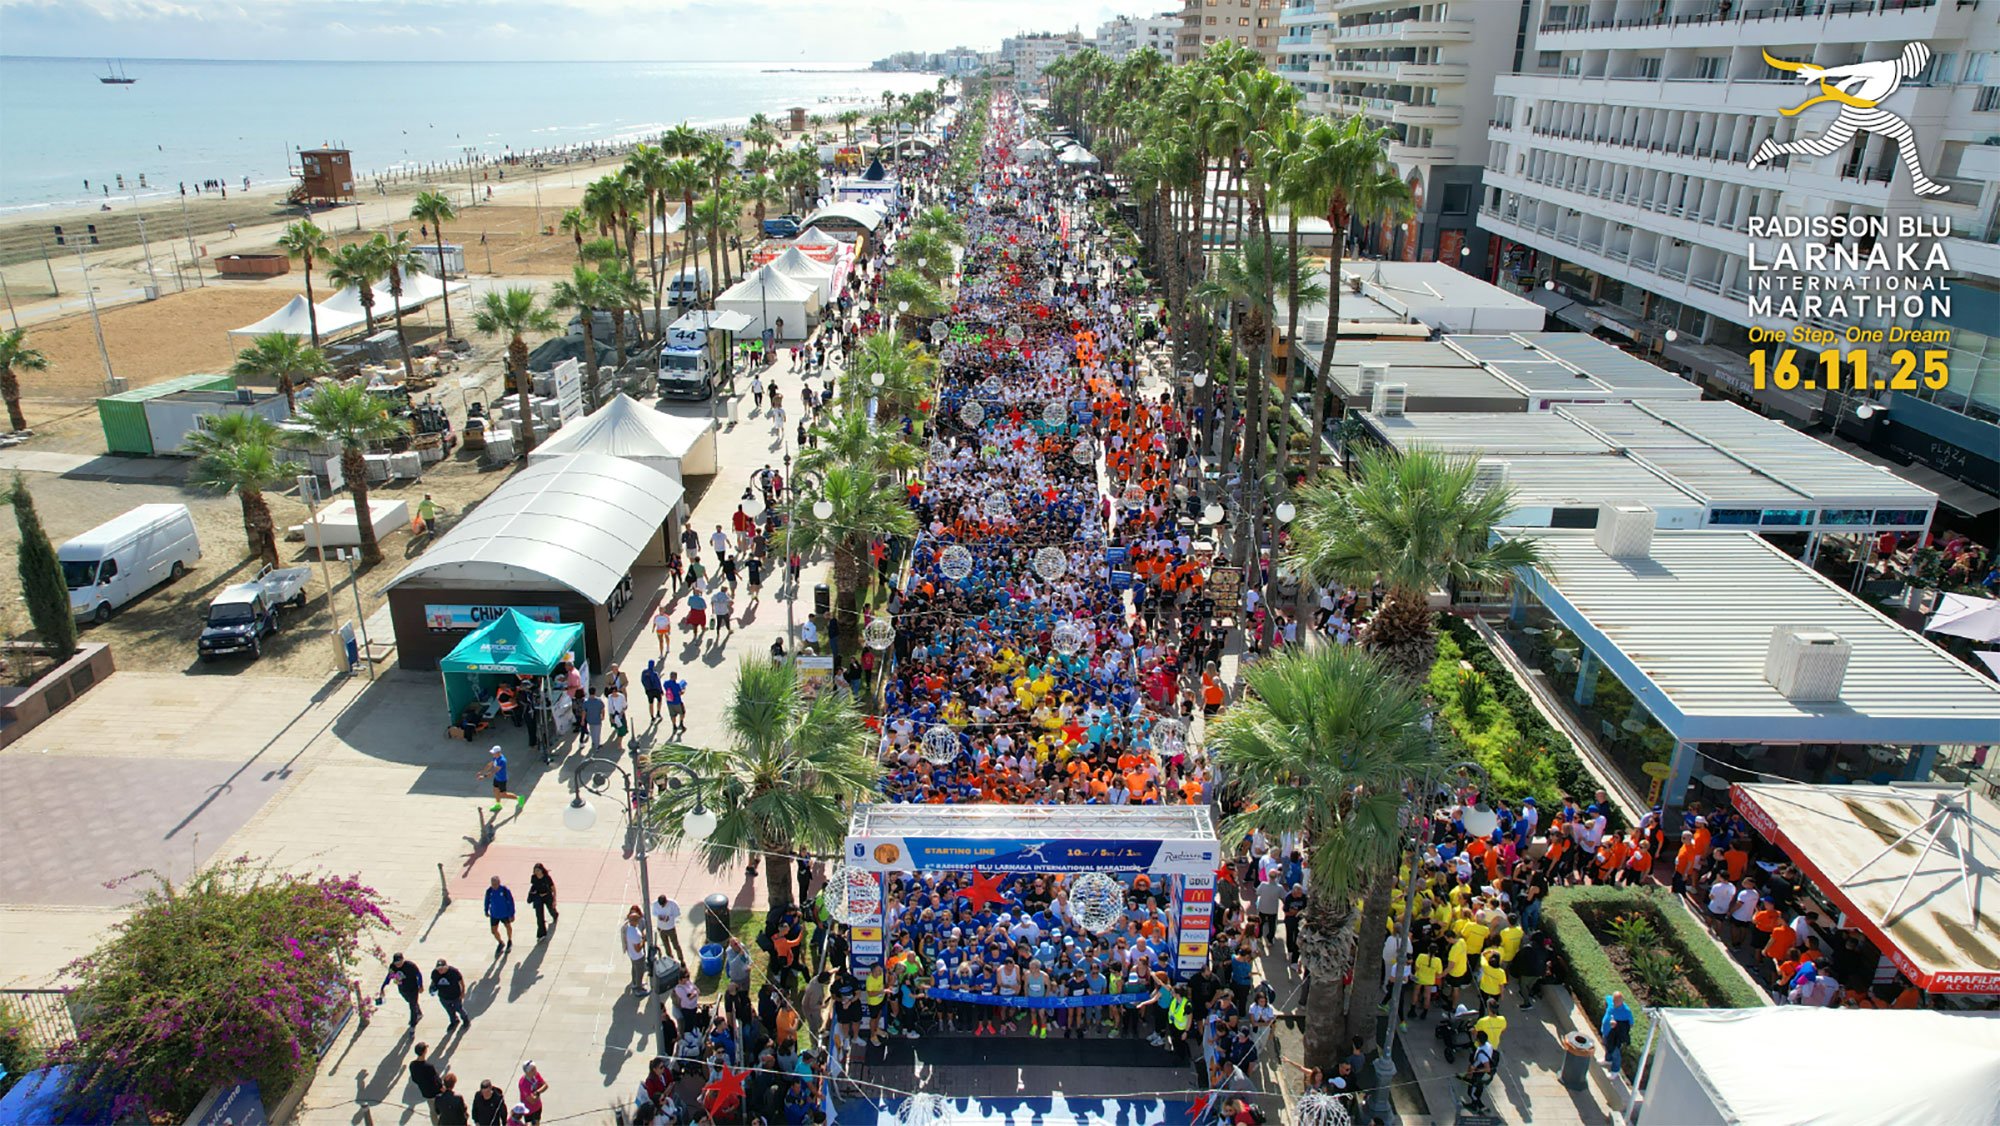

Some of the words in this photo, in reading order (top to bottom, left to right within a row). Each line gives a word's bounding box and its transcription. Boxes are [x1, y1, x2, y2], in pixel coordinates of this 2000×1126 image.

[676, 331, 696, 340] 44
[1931, 443, 1966, 467] PLAZA
[470, 607, 508, 622] CHIN
[479, 664, 518, 673] MOTOREX
[974, 848, 996, 856] LINE
[995, 863, 1032, 871] LARNAKA
